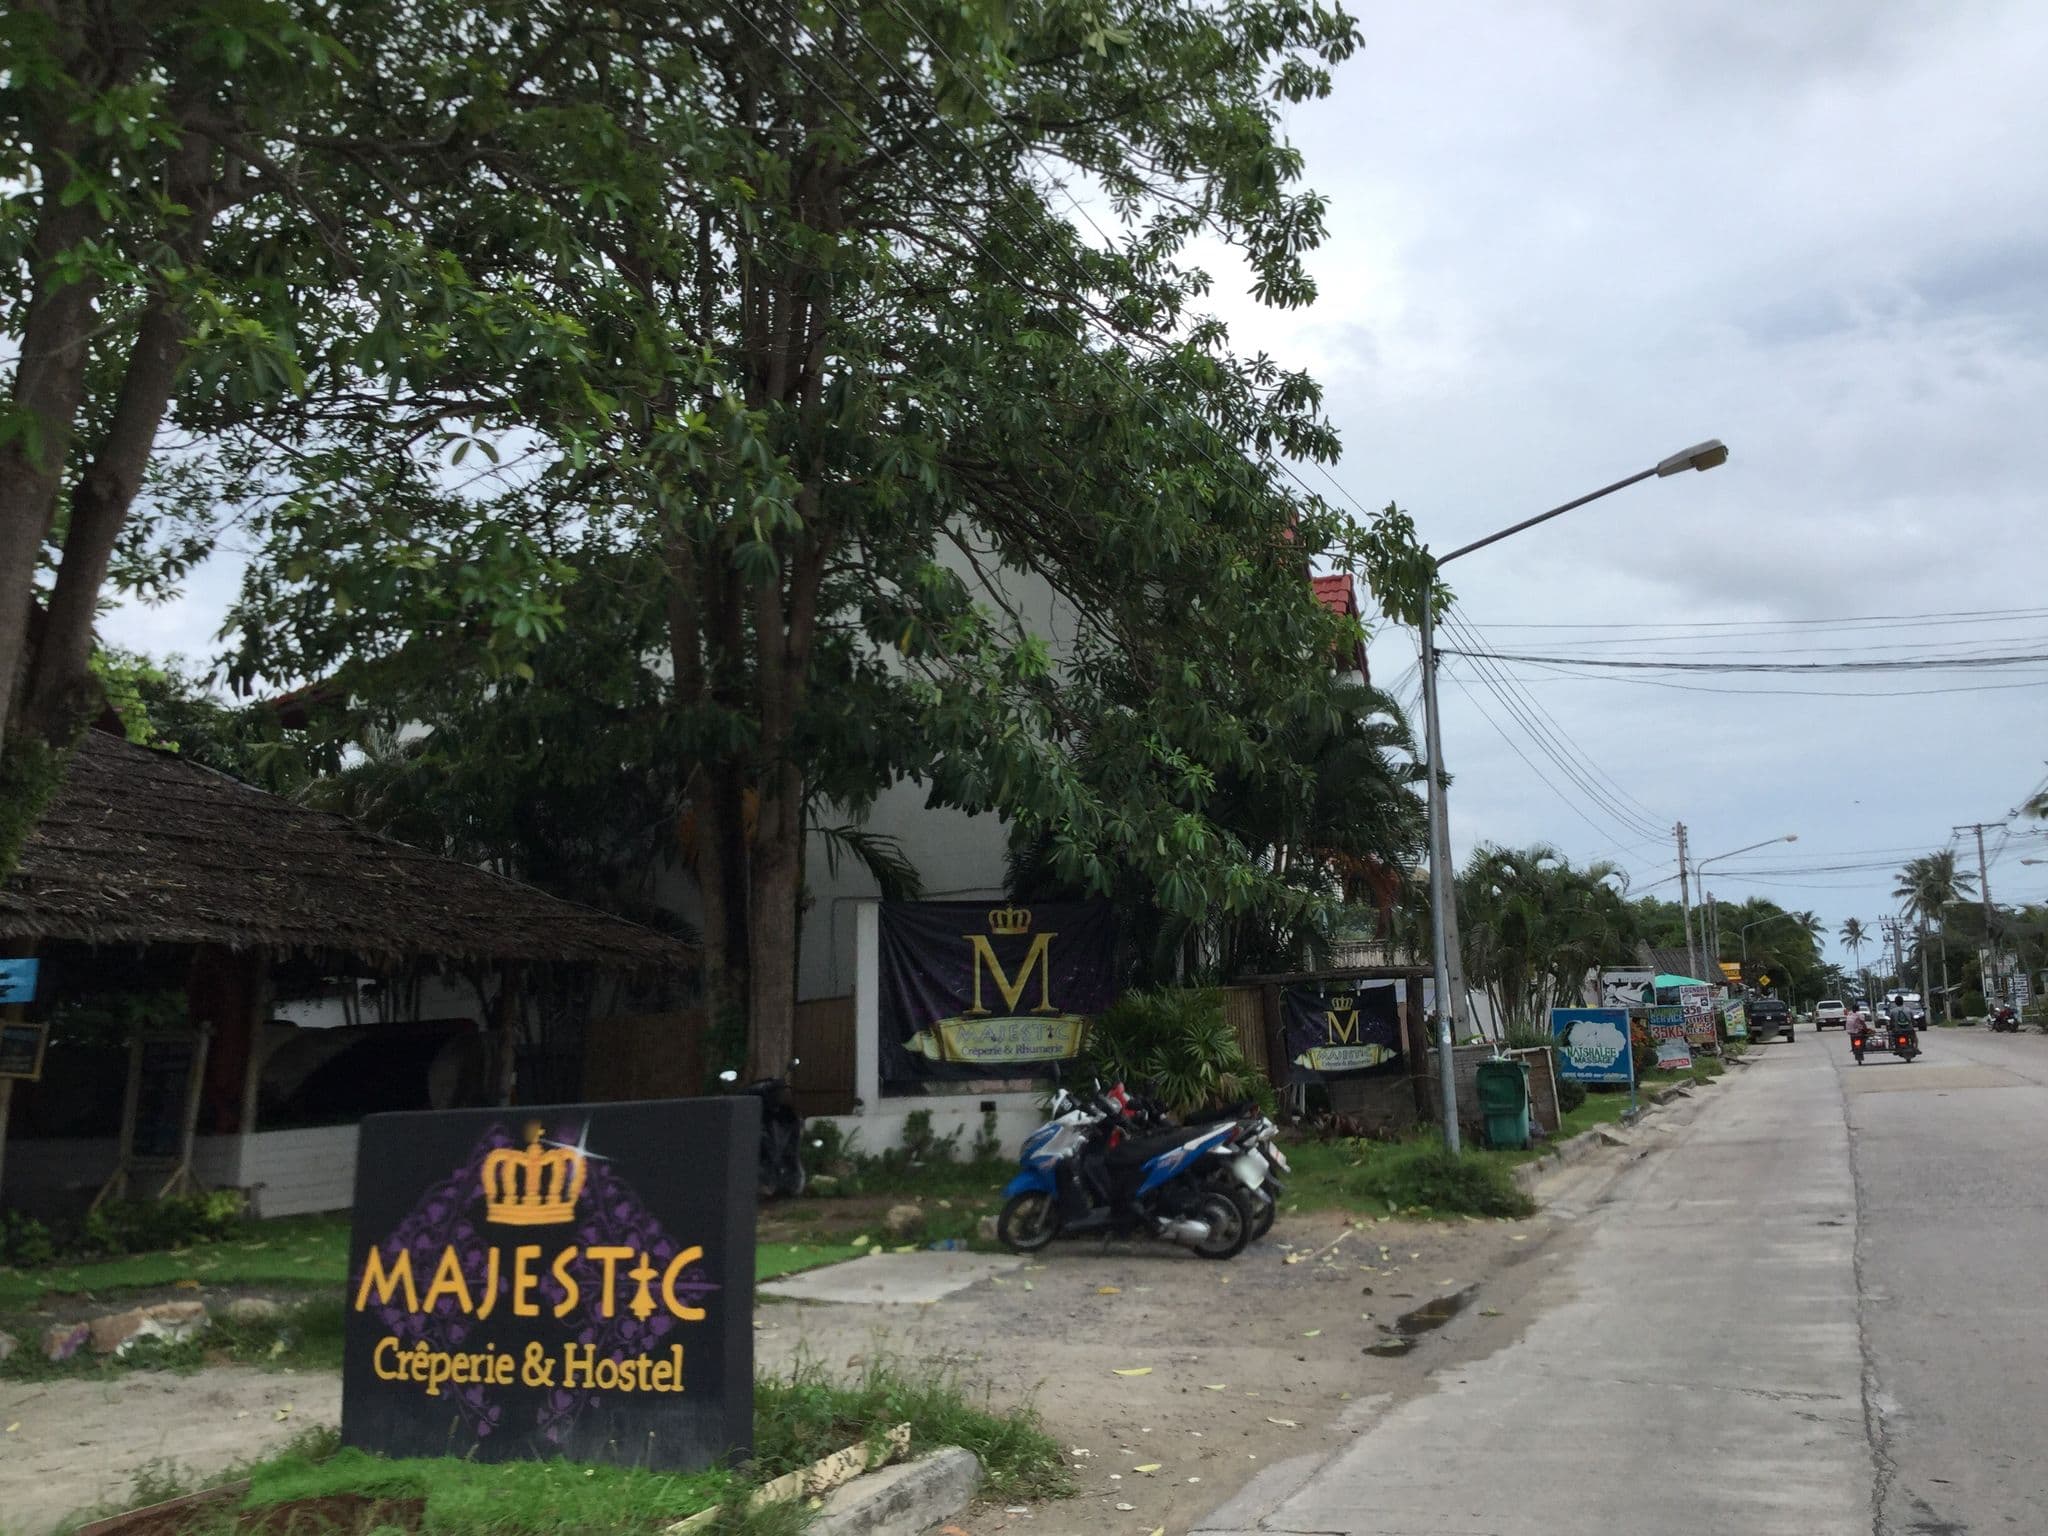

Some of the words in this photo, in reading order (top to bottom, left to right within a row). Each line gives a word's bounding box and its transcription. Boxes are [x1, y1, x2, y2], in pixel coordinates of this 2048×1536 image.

[962, 932, 1059, 1014] M
[956, 1023, 1070, 1041] MAJESTIC
[1324, 1010, 1362, 1045] M
[1650, 1014, 1684, 1024] SERVICE
[1652, 1025, 1684, 1039] 35KG
[1003, 1045, 1013, 1054] &
[355, 1245, 706, 1322] MAJESTIC
[373, 1336, 514, 1396] Crêperie
[521, 1341, 555, 1387] &
[564, 1342, 685, 1393] Hostel
